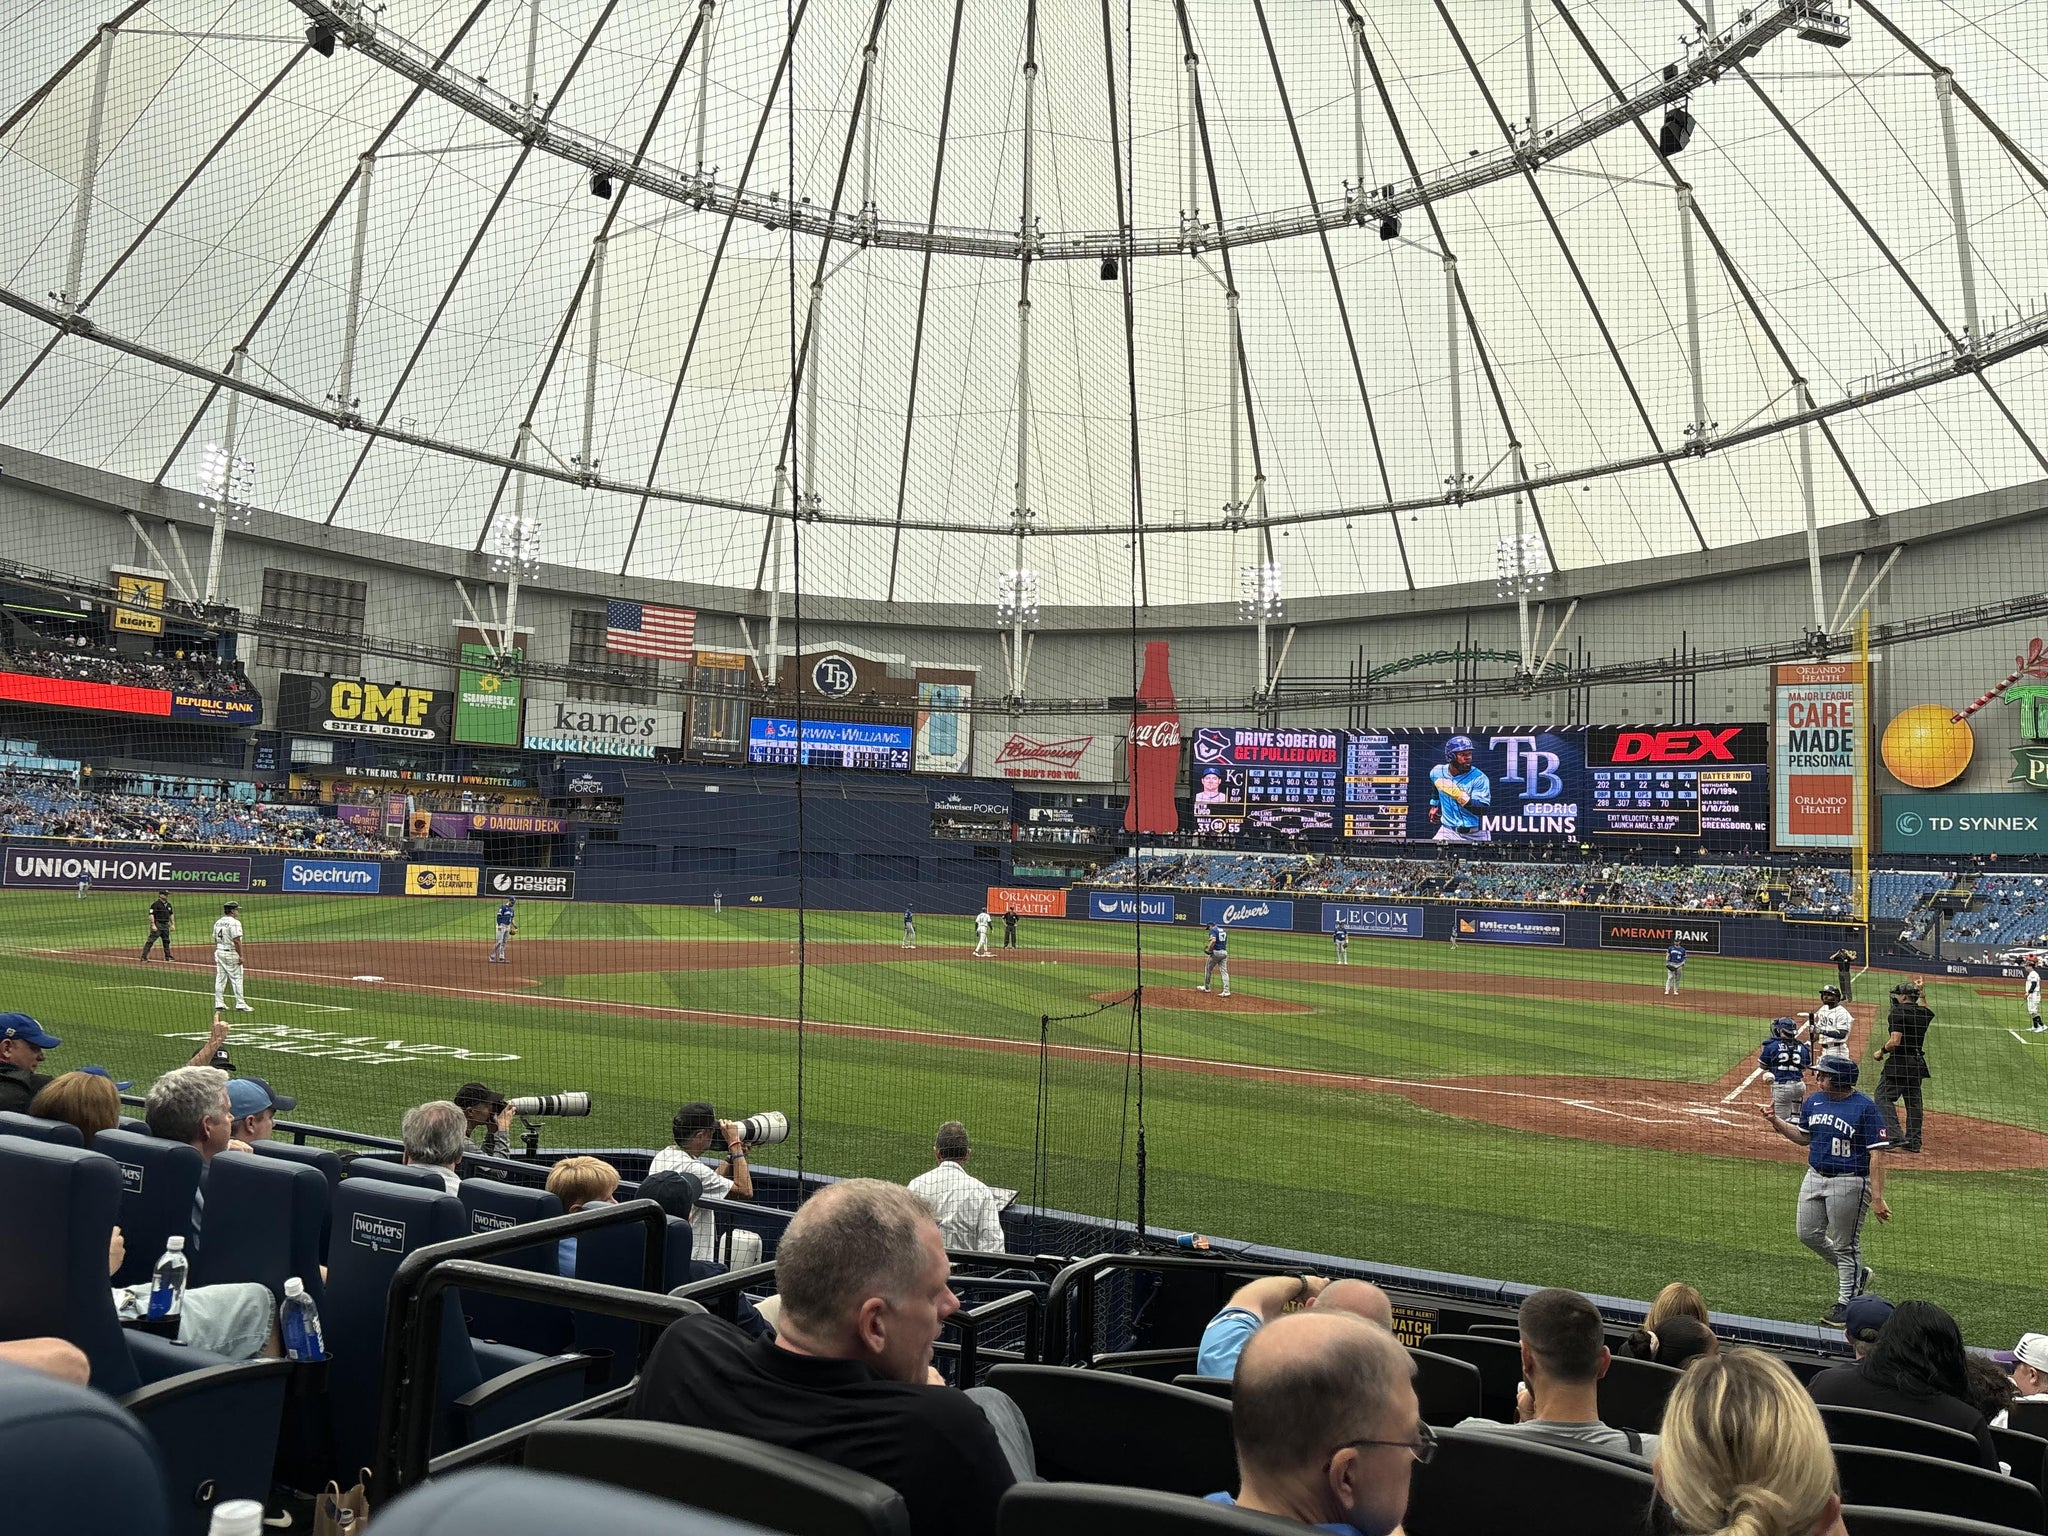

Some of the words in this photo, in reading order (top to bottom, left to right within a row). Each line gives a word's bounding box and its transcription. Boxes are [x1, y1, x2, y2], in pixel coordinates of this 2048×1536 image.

[120, 617, 156, 628] RIGHT.
[1796, 666, 1846, 675] ORLANDO
[1802, 674, 1841, 683] HEALTH
[1788, 691, 1819, 701] MAJOR
[1821, 690, 1853, 701] LEAGUE
[175, 696, 224, 709] REPUBLIC
[225, 701, 254, 713] BANK
[330, 681, 434, 726] GMF
[553, 702, 656, 737] kane's
[1788, 701, 1853, 729] CARE
[331, 721, 377, 733] STEEL
[381, 727, 429, 738] GROUP
[562, 733, 645, 746] FURNITURE
[1235, 731, 1274, 746] DRIVE
[1276, 733, 1317, 748] SOBER
[1319, 734, 1336, 749] OR
[1611, 727, 1743, 762] DEX
[1789, 729, 1853, 753] MADE
[890, 750, 909, 763] 2-2
[1004, 741, 1082, 759] Budweiser
[1234, 746, 1259, 760] GET
[1260, 747, 1305, 762] PULLED
[1306, 748, 1337, 763] OVER
[1489, 735, 1563, 800] TB
[1789, 754, 1853, 768] PERSONAL
[345, 767, 357, 776] WE
[365, 768, 380, 777] THE
[380, 769, 400, 778] RAYS.
[400, 771, 411, 779] WE
[437, 774, 455, 783] PETE
[462, 775, 527, 788] WWW.STPETE.ORG
[1004, 768, 1022, 777] THIS
[1023, 769, 1045, 778] BUD'S
[1047, 770, 1062, 778] FOR
[1063, 770, 1081, 779] YOU.
[1225, 769, 1244, 786] KC
[1702, 772, 1731, 780] BATTER
[1732, 772, 1750, 780] INFO
[1286, 778, 1300, 786] 90.0
[1304, 778, 1318, 786] 4.20
[1595, 781, 1610, 789] .202
[1638, 781, 1648, 789] 22
[1659, 781, 1670, 789] 46
[1684, 781, 1690, 789] 4
[568, 784, 603, 794] PORCH
[1231, 788, 1240, 796] 67
[1701, 787, 1738, 795] 10/1/1994
[1251, 794, 1260, 802] 94
[1616, 799, 1630, 807] .307
[1636, 800, 1651, 808] .595
[1660, 799, 1669, 807] 70
[1795, 796, 1847, 805] ORLANDO
[367, 808, 379, 816] FAN
[934, 801, 973, 811] Budweiser
[973, 803, 1009, 815] PORCH
[1525, 803, 1578, 815] CEDRIC
[1701, 804, 1739, 813] 8/10/2018
[1801, 804, 1841, 814] HEALTH
[349, 816, 379, 825] FAVORITE
[490, 816, 532, 831] DAIQUIRI
[534, 819, 560, 833] DECK
[1481, 814, 1576, 834] MULLINS
[1607, 814, 1621, 822] EXIT
[1621, 814, 1651, 822] VELOCITY:
[1665, 815, 1680, 823] MPH
[1928, 817, 1953, 831] TD
[1959, 817, 2038, 832] SYNNEX
[1198, 823, 1210, 833] 33
[1228, 823, 1240, 833] 55
[1610, 821, 1634, 829] LAUNCH
[1634, 822, 1656, 830] ANGLE:
[1701, 821, 1753, 831] GREENSBORO,
[1754, 823, 1766, 831] NC
[1567, 835, 1577, 843] 31
[172, 870, 241, 883] MORTGAGE
[291, 864, 367, 886] Spectrum
[438, 880, 473, 889] CLEARWATER
[1000, 890, 1055, 903] ORLANDO
[1005, 901, 1051, 914] HEALTH
[1120, 900, 1165, 915] Webull
[1222, 902, 1270, 924] Culver's
[1479, 921, 1560, 932] MicroLumen
[217, 928, 224, 940] 4
[1610, 927, 1674, 940] AMERANT
[1675, 930, 1709, 942] BANK
[1952, 965, 1968, 974] RIPA
[2008, 969, 2024, 978] RIPA
[1834, 1116, 1856, 1139] CITY
[1831, 1137, 1851, 1157] 88
[474, 1212, 489, 1226] two
[489, 1215, 514, 1229] rivers
[355, 1217, 372, 1232] two
[372, 1220, 403, 1240] rivers
[1415, 1310, 1435, 1319] ALERT!
[1397, 1333, 1422, 1347] OUT
